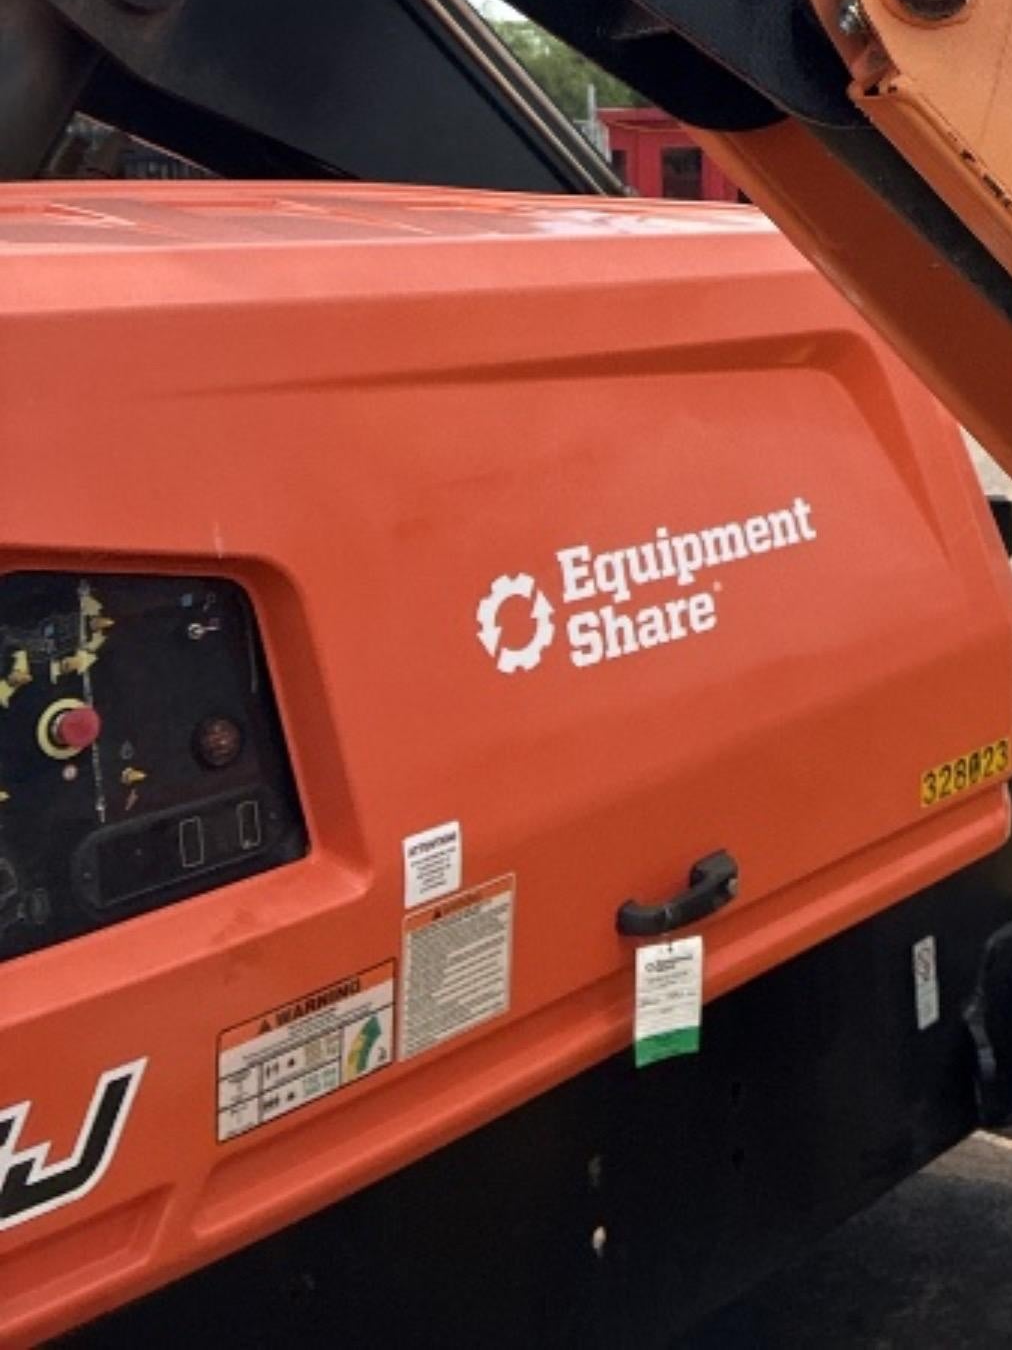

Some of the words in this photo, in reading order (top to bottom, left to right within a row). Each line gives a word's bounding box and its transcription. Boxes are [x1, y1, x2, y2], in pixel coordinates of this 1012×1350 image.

[555, 497, 817, 603] Equipment
[566, 591, 718, 668] Share
[275, 976, 361, 1026] WARNING
